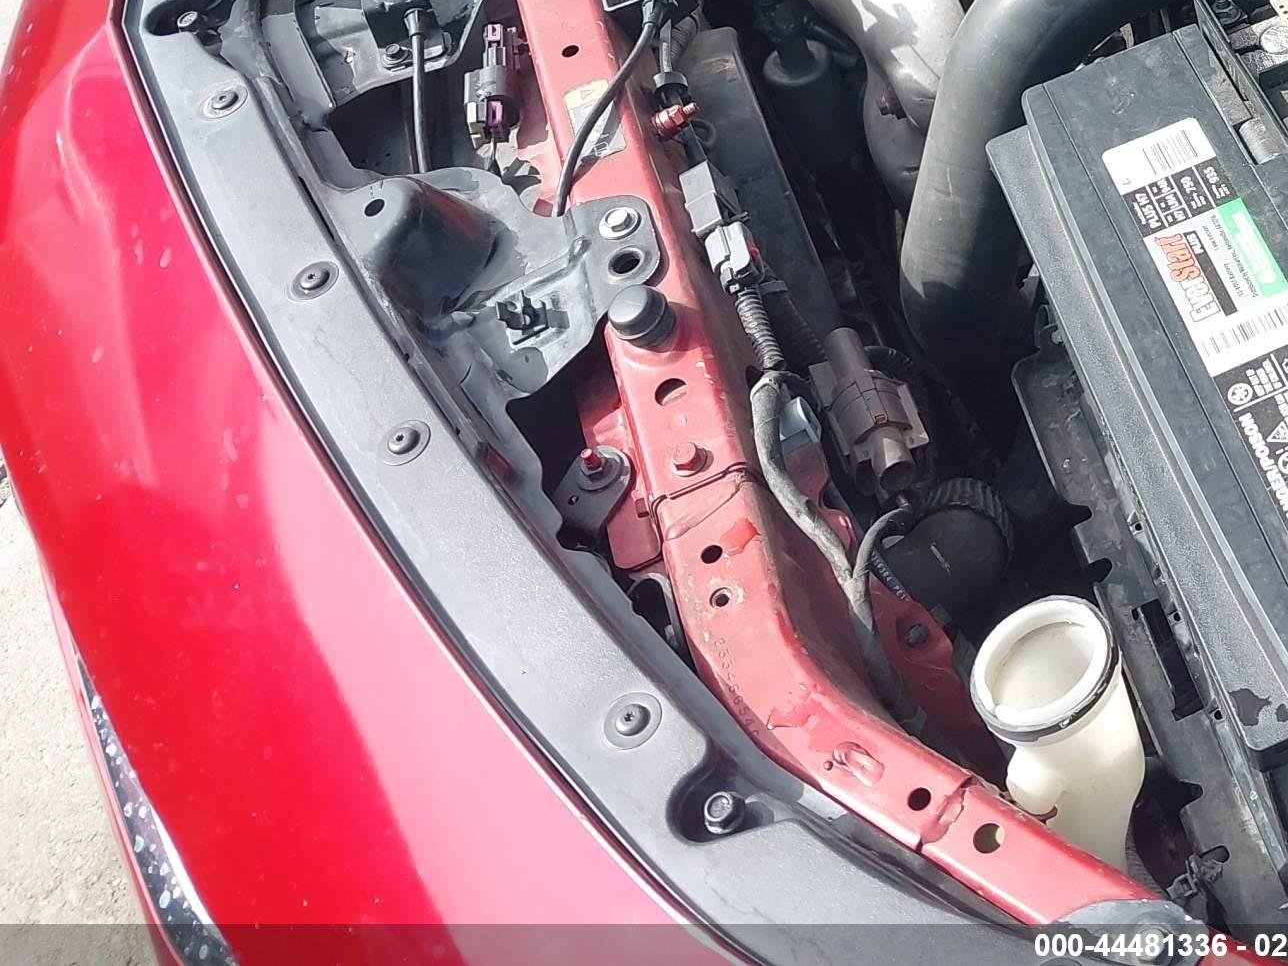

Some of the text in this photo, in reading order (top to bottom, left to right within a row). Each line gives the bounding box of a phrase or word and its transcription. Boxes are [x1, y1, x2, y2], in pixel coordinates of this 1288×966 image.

[1180, 175, 1196, 193] 750
[1203, 166, 1219, 183] 935
[1135, 191, 1149, 205] H7
[1141, 204, 1161, 228] PLUS
[1186, 232, 1203, 254] PLUS
[1153, 230, 1220, 322] EverStart
